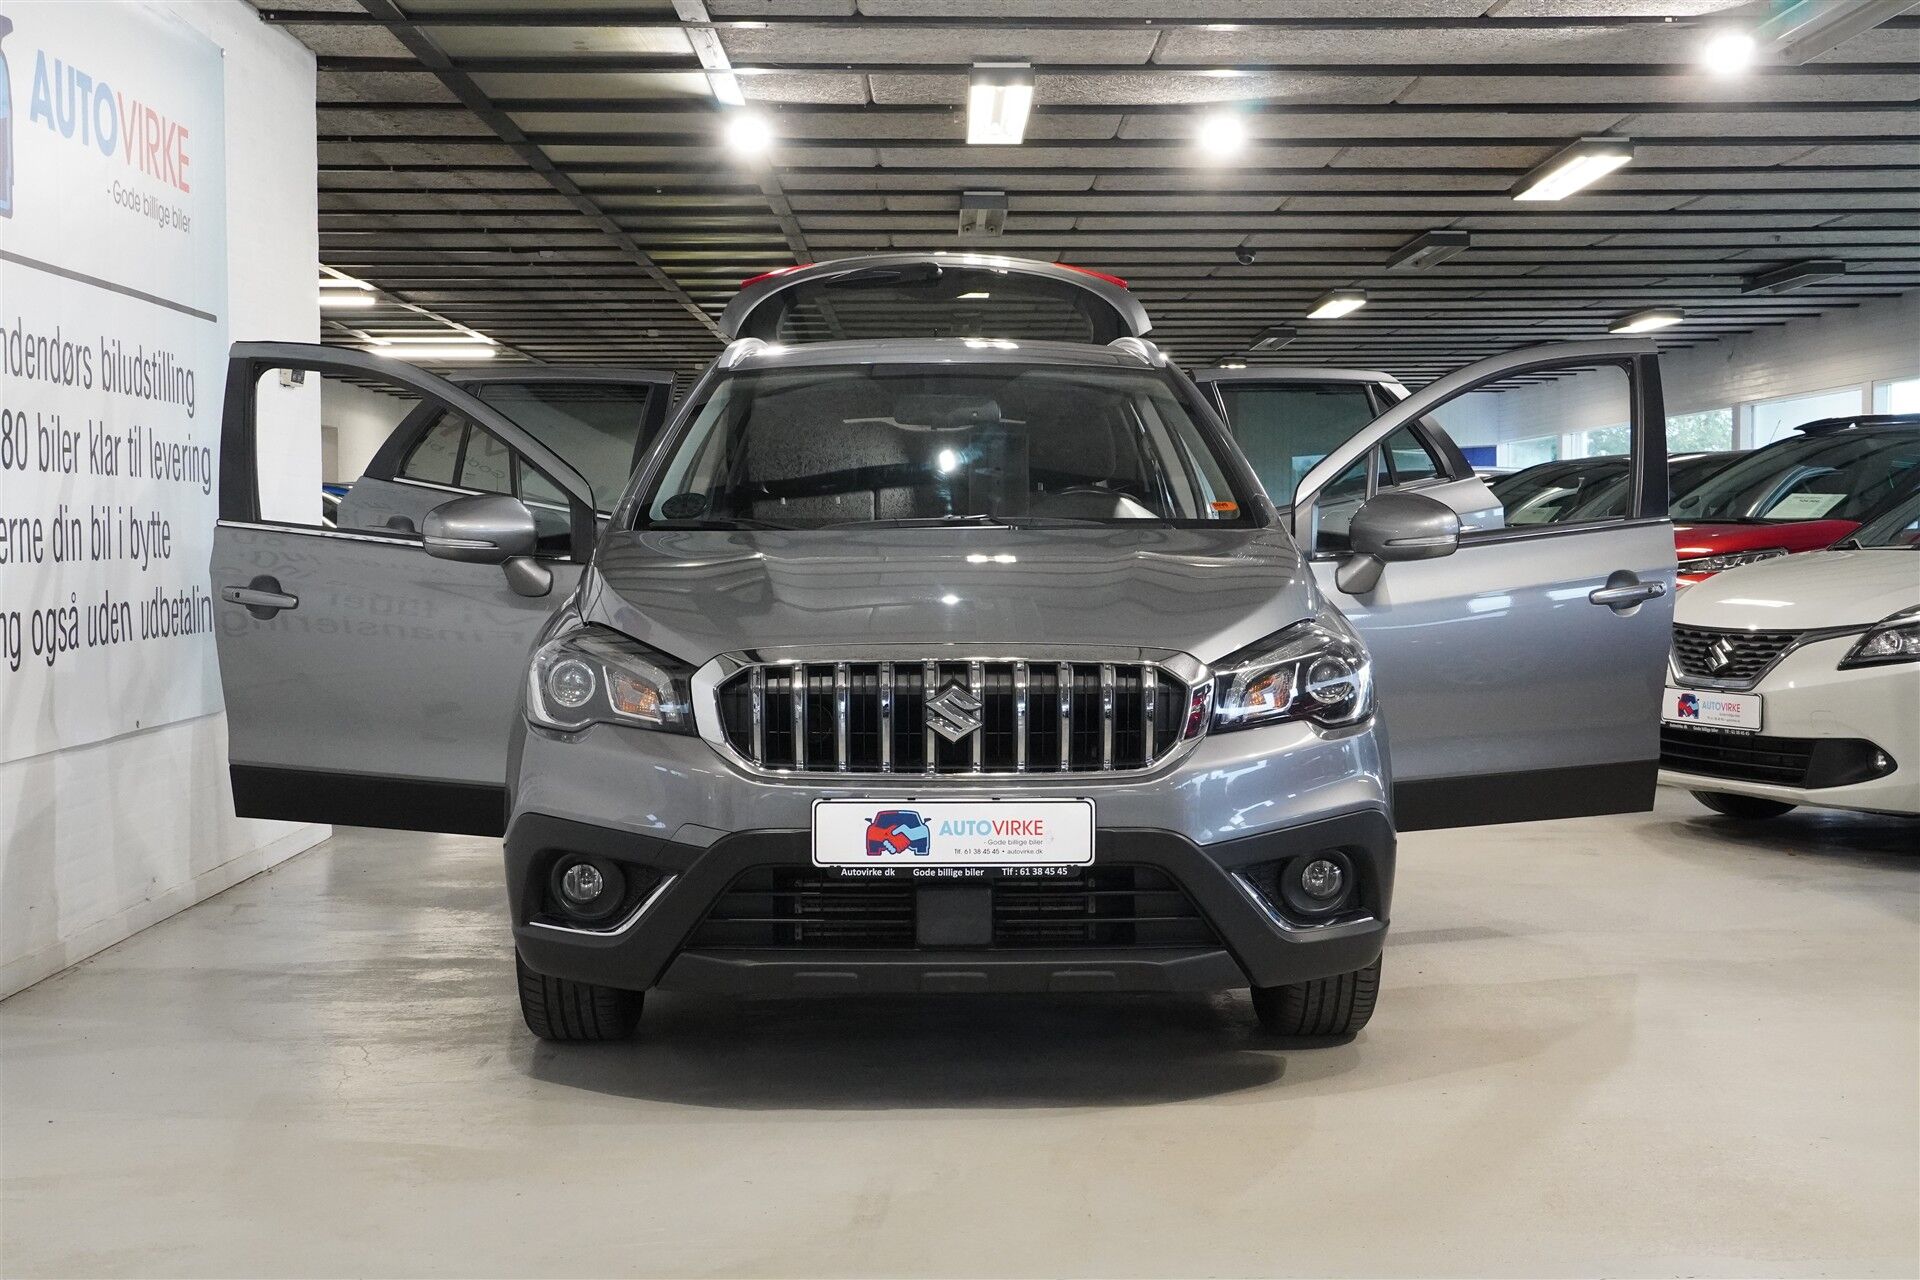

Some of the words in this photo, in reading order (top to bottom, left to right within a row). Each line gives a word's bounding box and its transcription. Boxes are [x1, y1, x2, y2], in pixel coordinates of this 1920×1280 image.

[29, 48, 190, 193] AUTOVIRKE
[113, 180, 140, 212] Gode
[143, 192, 170, 228] billige
[172, 205, 191, 233] biler
[101, 335, 195, 419] biludstilling
[1, 408, 28, 471] 80
[38, 412, 81, 474] biler
[89, 419, 122, 476] klar
[128, 425, 142, 478] til
[149, 427, 212, 496] levering
[53, 504, 83, 563] din
[91, 504, 112, 561] bil
[118, 506, 123, 560] i
[130, 506, 171, 572] bytte
[31, 591, 80, 667] også
[87, 589, 133, 647] uden
[1702, 701, 1741, 713] AUTOVIRKE
[938, 820, 1043, 836] AUTOVIRKE
[1008, 839, 1027, 847] billige
[841, 868, 882, 876] Autovirke
[885, 868, 895, 876] dk
[913, 868, 936, 876] Gode
[937, 868, 963, 878] billige
[964, 868, 984, 876] biler
